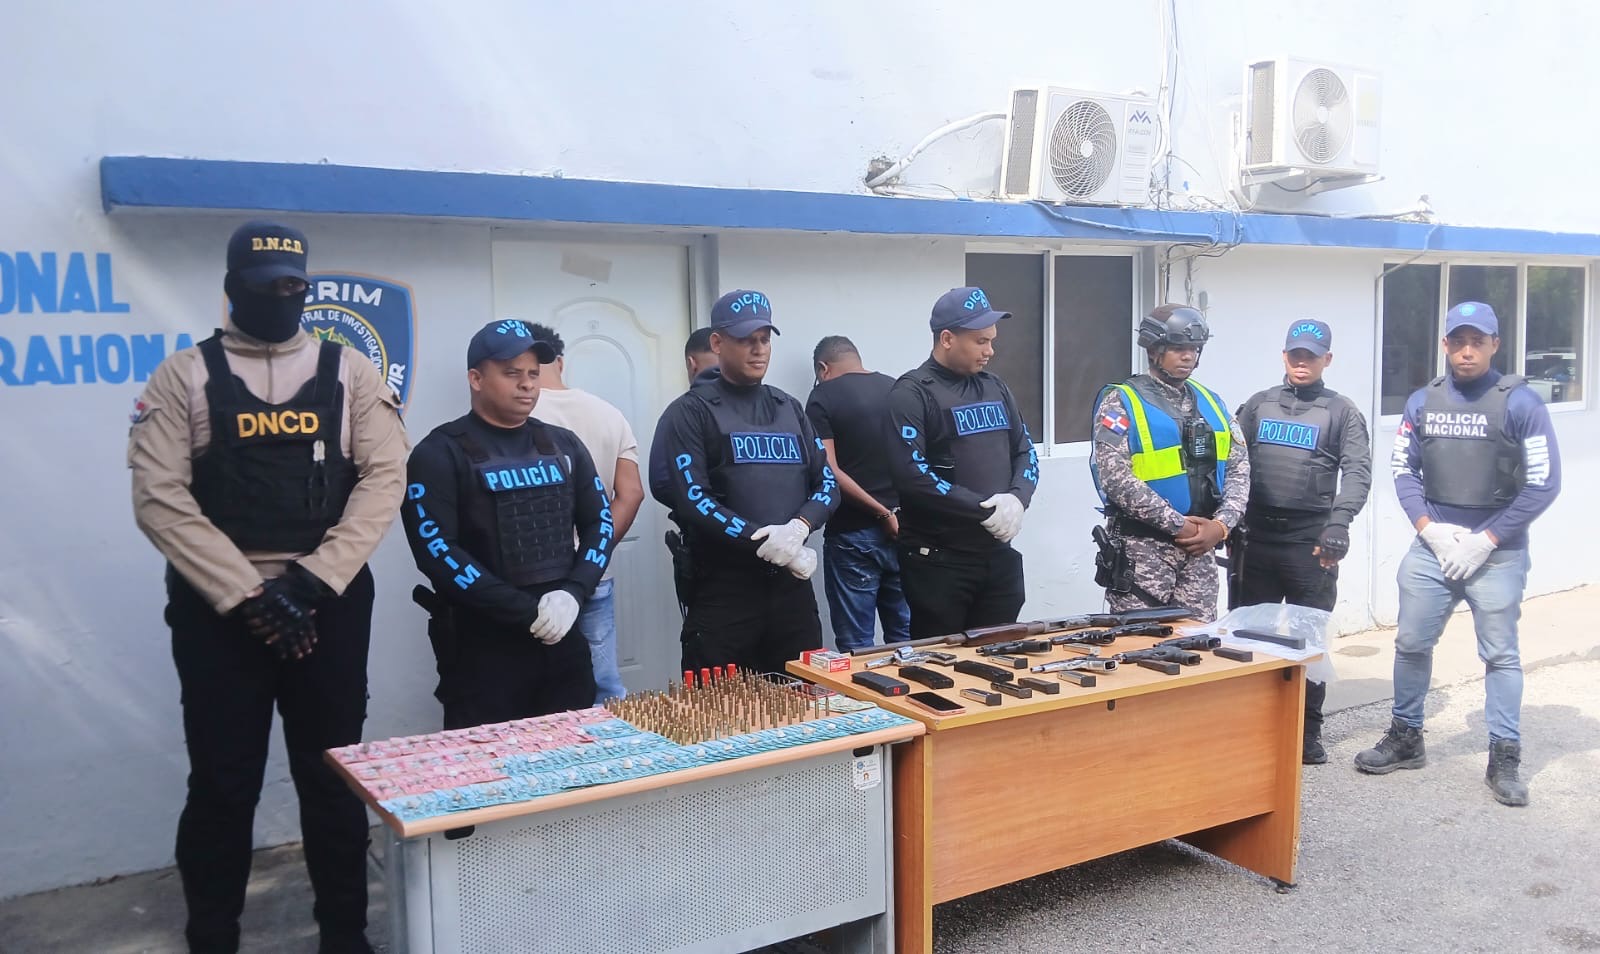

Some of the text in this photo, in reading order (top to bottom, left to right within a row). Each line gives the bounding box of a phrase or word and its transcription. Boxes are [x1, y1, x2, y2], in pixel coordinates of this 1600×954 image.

[328, 310, 341, 321] DE
[1292, 324, 1324, 340] DICRIM
[237, 410, 319, 438] DNCD
[955, 405, 1007, 431] POLICIA
[1425, 423, 1488, 437] NACIONAL
[1260, 421, 1313, 445] POLICIA
[733, 436, 800, 460] POLICIA
[485, 460, 564, 490] POLICÍA
[675, 453, 746, 538] DICRIM
[407, 483, 481, 590] DICRIM
